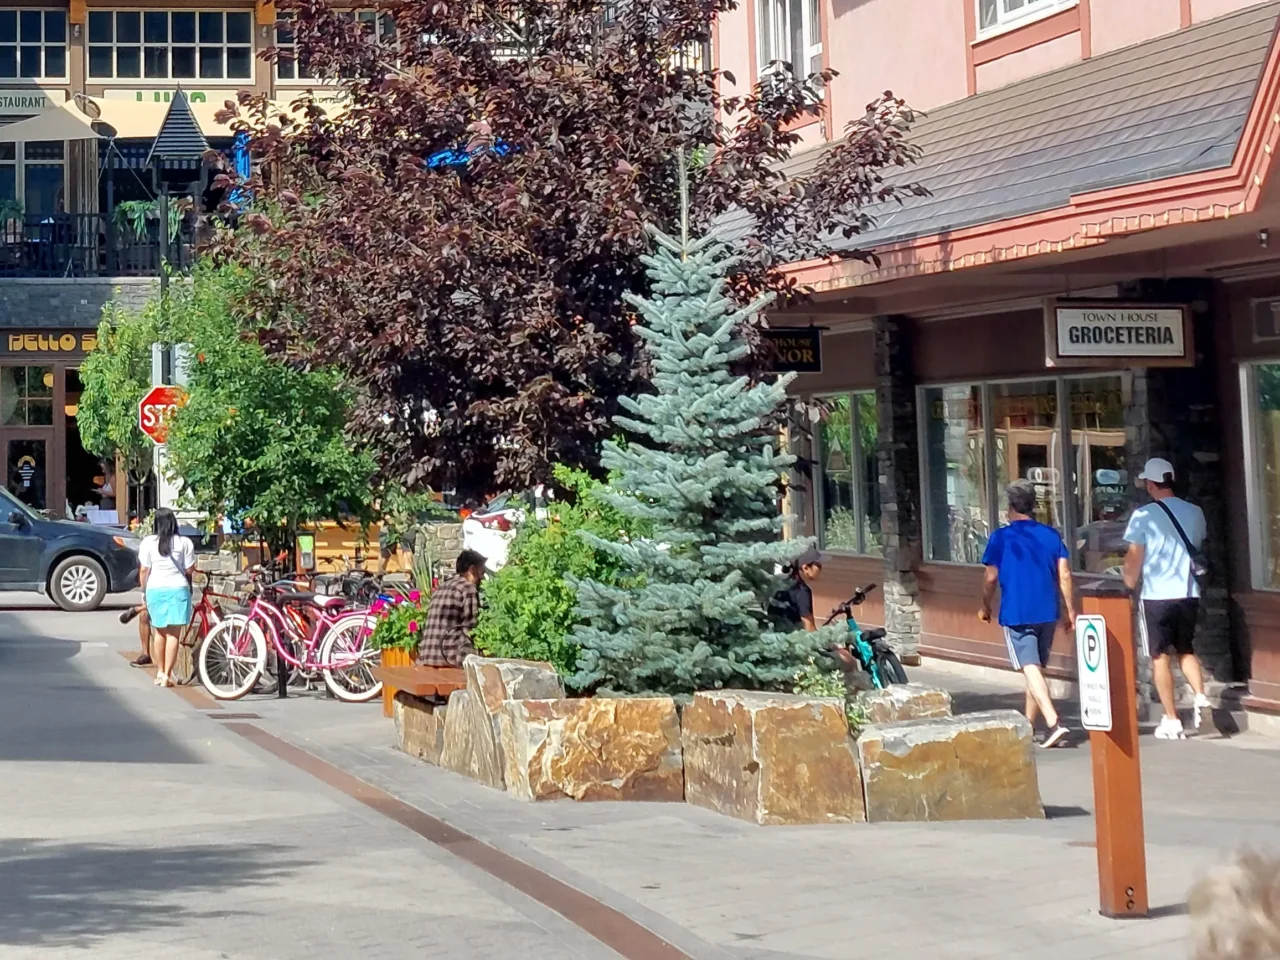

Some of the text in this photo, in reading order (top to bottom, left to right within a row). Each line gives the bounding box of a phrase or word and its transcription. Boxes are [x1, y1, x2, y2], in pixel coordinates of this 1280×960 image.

[1081, 312, 1160, 323] TOWN HOUSE
[8, 333, 77, 352] HELLO
[1069, 325, 1175, 345] GROCETERIA
